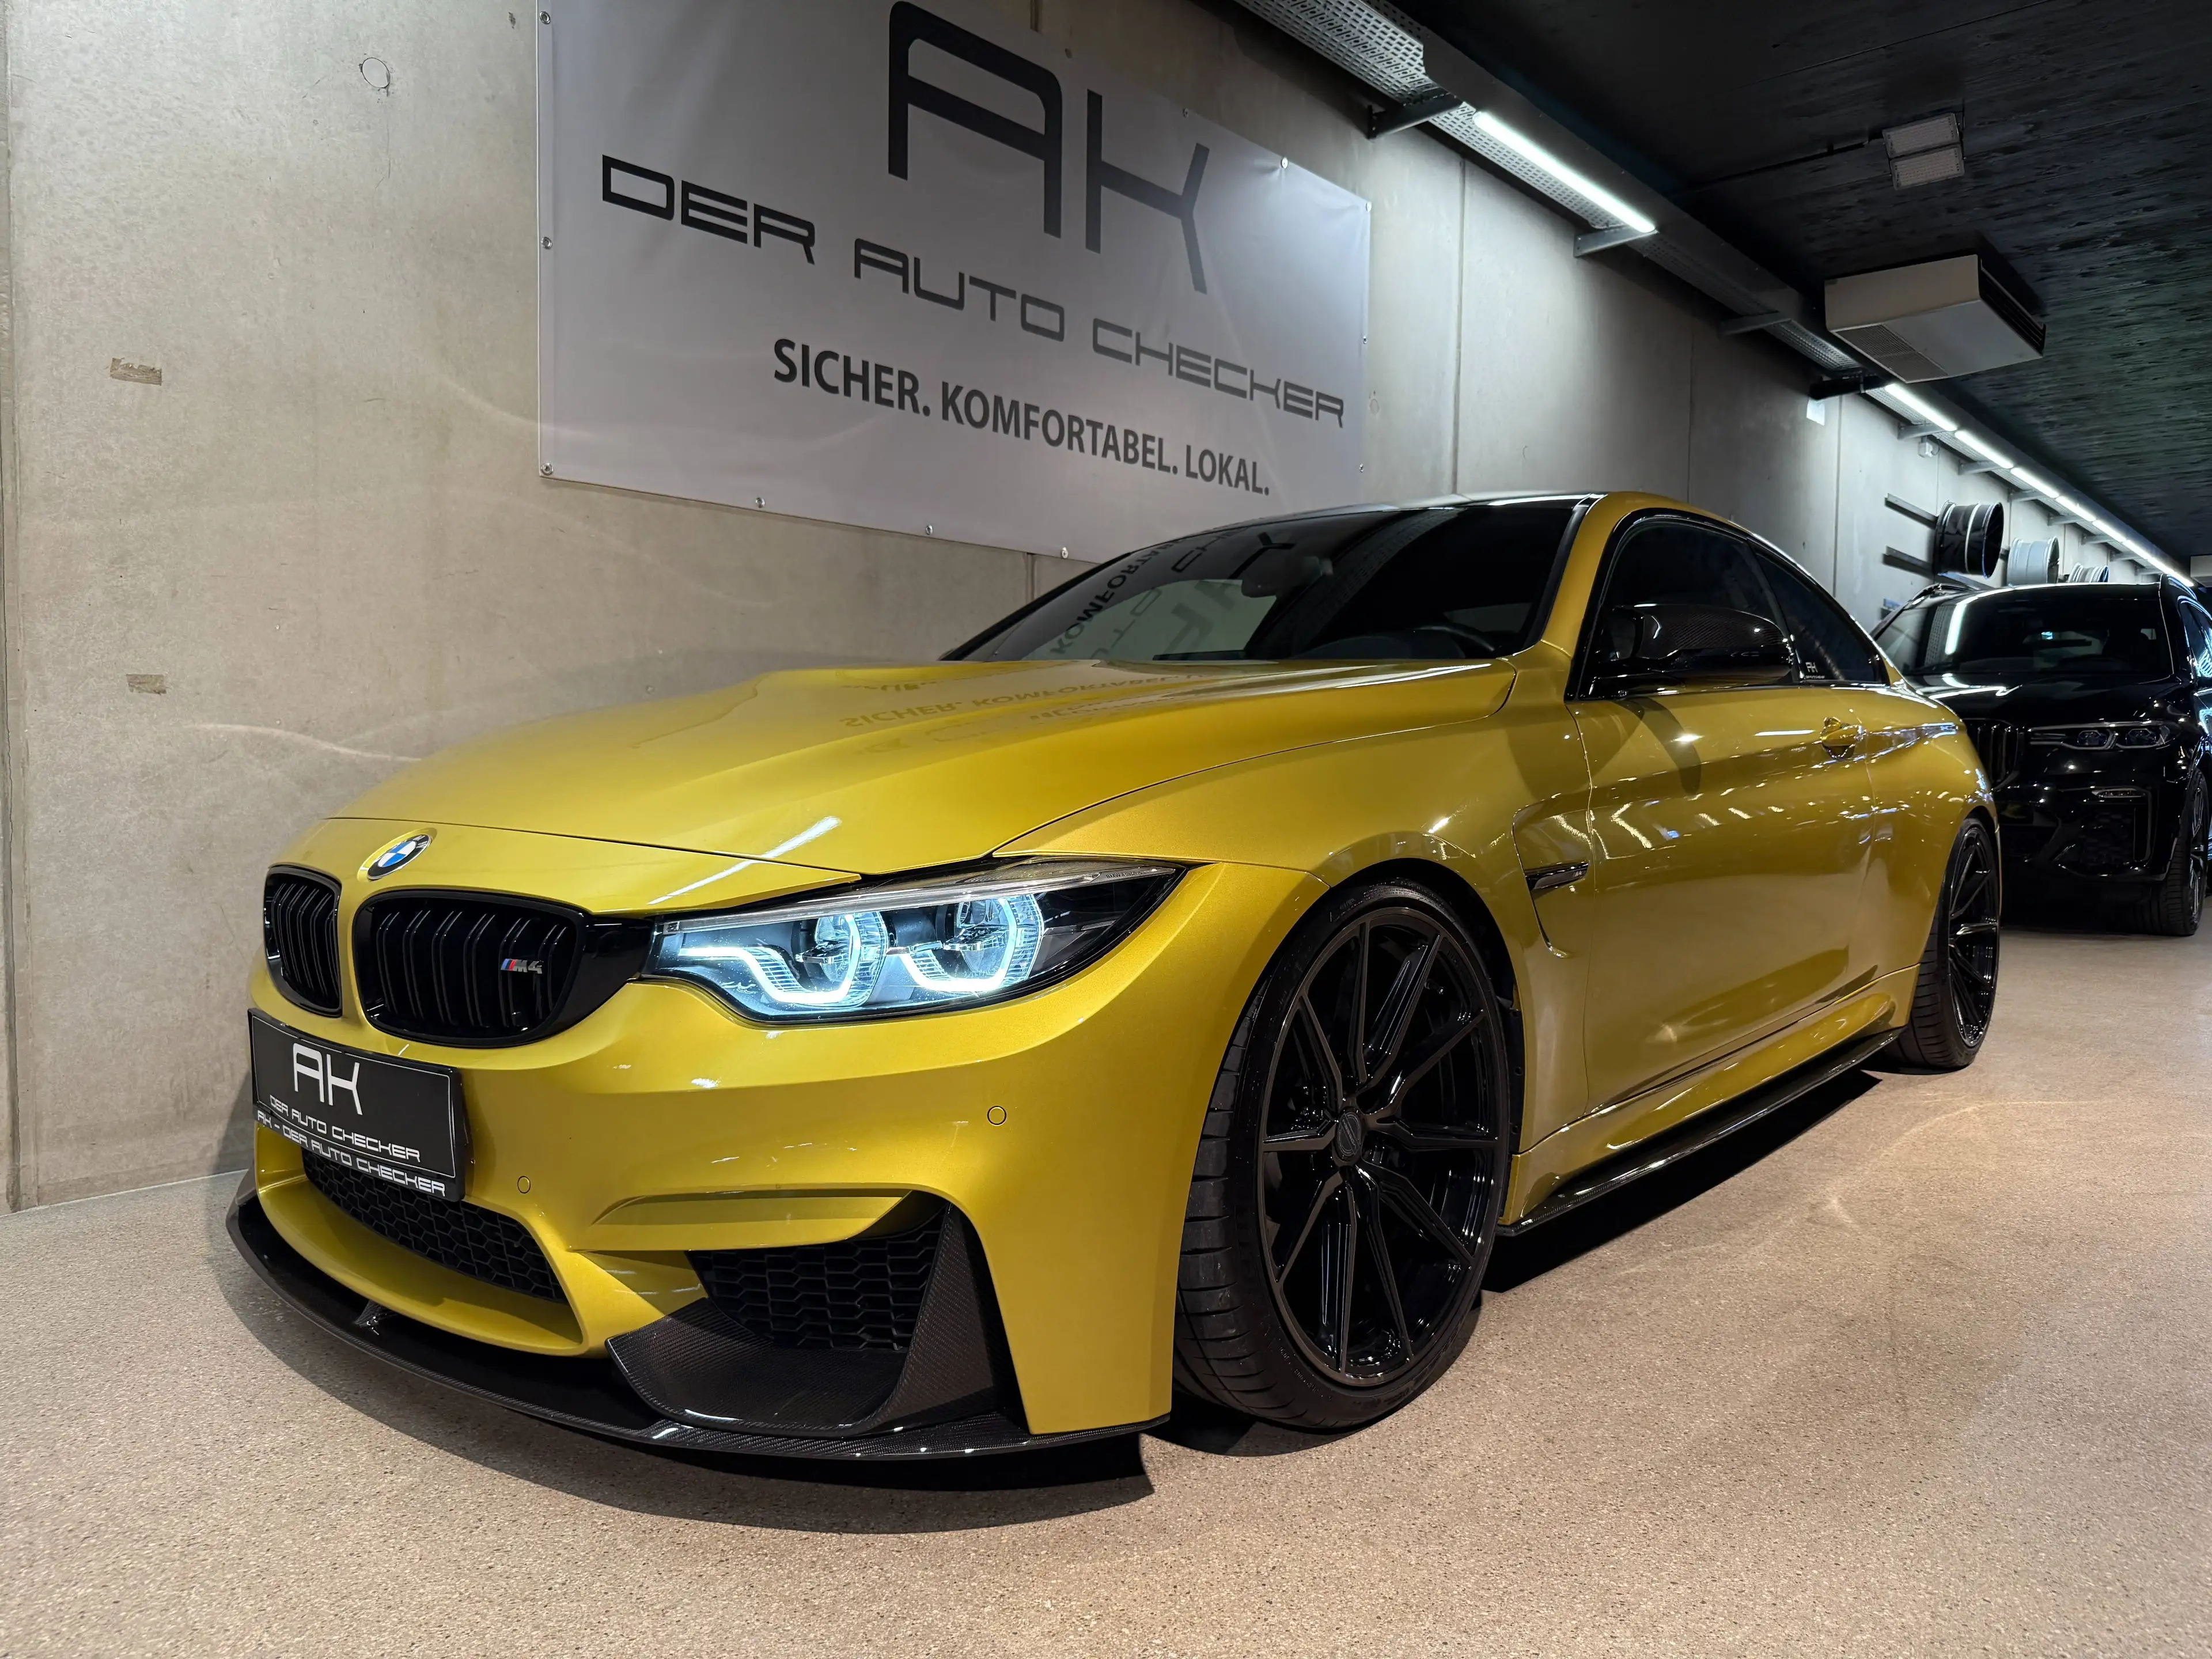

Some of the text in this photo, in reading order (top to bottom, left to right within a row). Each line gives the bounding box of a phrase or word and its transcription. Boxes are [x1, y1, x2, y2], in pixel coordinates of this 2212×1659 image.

[888, 1, 1209, 294] AK
[603, 154, 1343, 428] DER AUTO CHECKER
[774, 339, 1270, 496] SICHER. KOMFORTABEL. LOKAL.
[512, 959, 544, 974] M4
[293, 1043, 363, 1115] AK
[257, 1109, 272, 1128] AK
[282, 1124, 309, 1147] DER
[311, 1139, 353, 1166] AUTO
[356, 1157, 445, 1197] CHECKER
[270, 1094, 421, 1162] DER AUTO CHECKER
